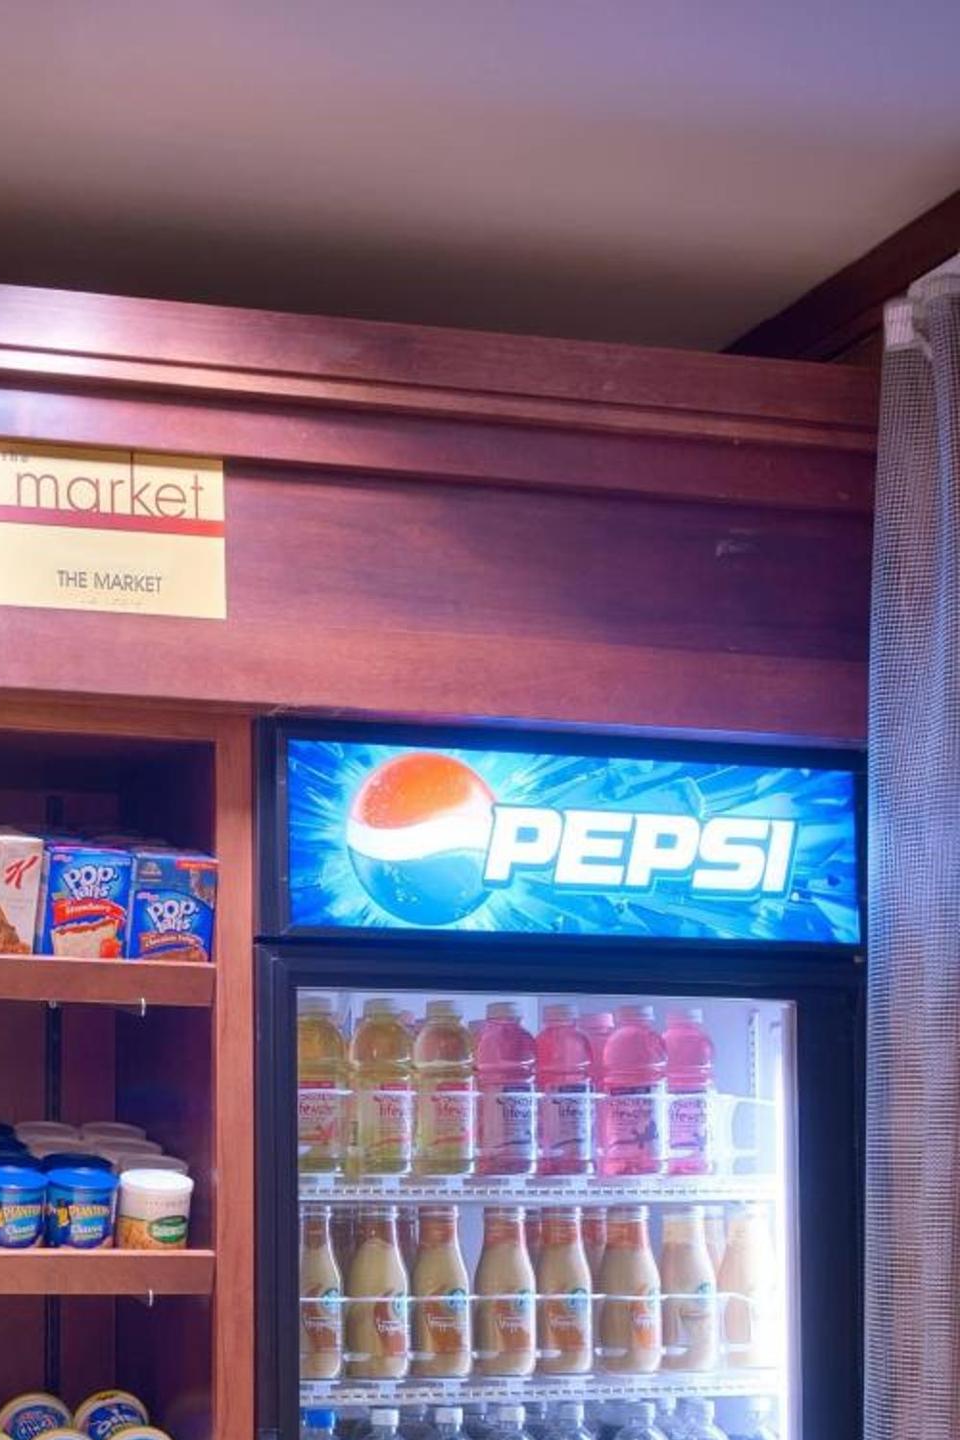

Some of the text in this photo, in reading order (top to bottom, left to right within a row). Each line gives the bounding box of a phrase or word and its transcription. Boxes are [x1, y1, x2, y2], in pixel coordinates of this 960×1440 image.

[15, 452, 204, 520] market
[57, 570, 162, 593] THE MARKET
[5, 855, 39, 889] K
[483, 804, 798, 893] PEPSI
